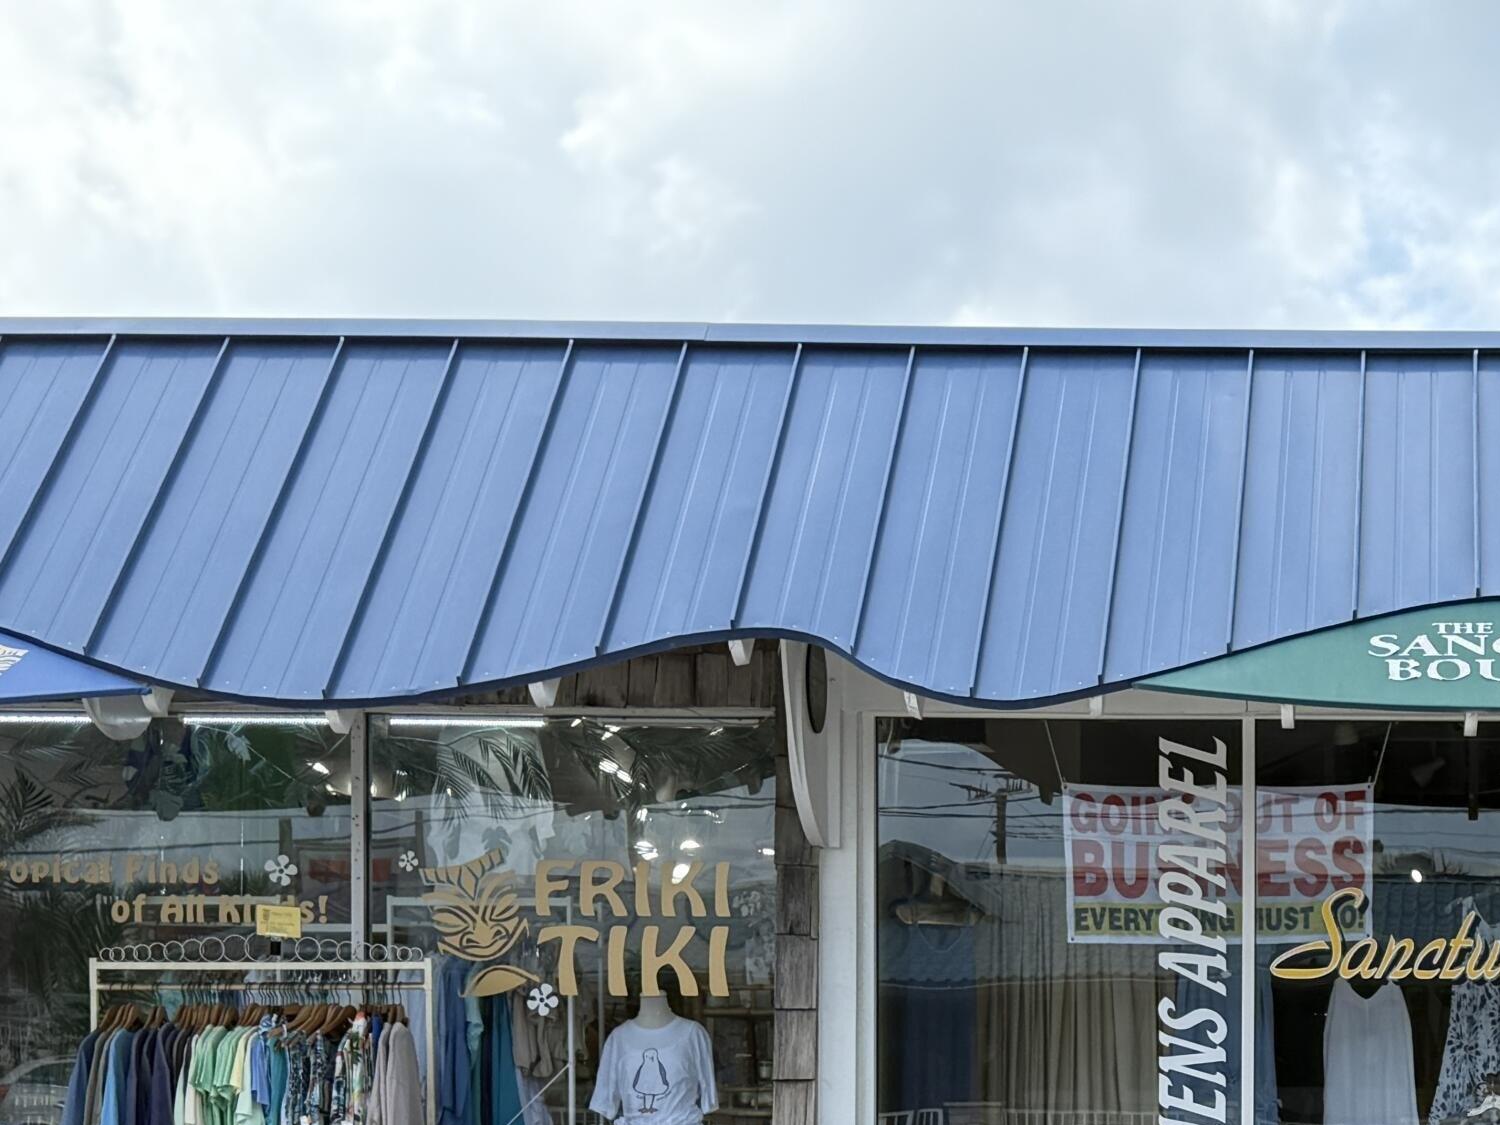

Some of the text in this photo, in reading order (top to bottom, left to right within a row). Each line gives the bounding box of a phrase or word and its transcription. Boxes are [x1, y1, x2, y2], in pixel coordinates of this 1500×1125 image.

[1431, 622, 1494, 634] THE
[1314, 790, 1367, 833] OF
[534, 859, 732, 918] FRIKI
[1158, 735, 1228, 997] APPAREL
[110, 894, 146, 924] of
[536, 925, 731, 997] TIKI
